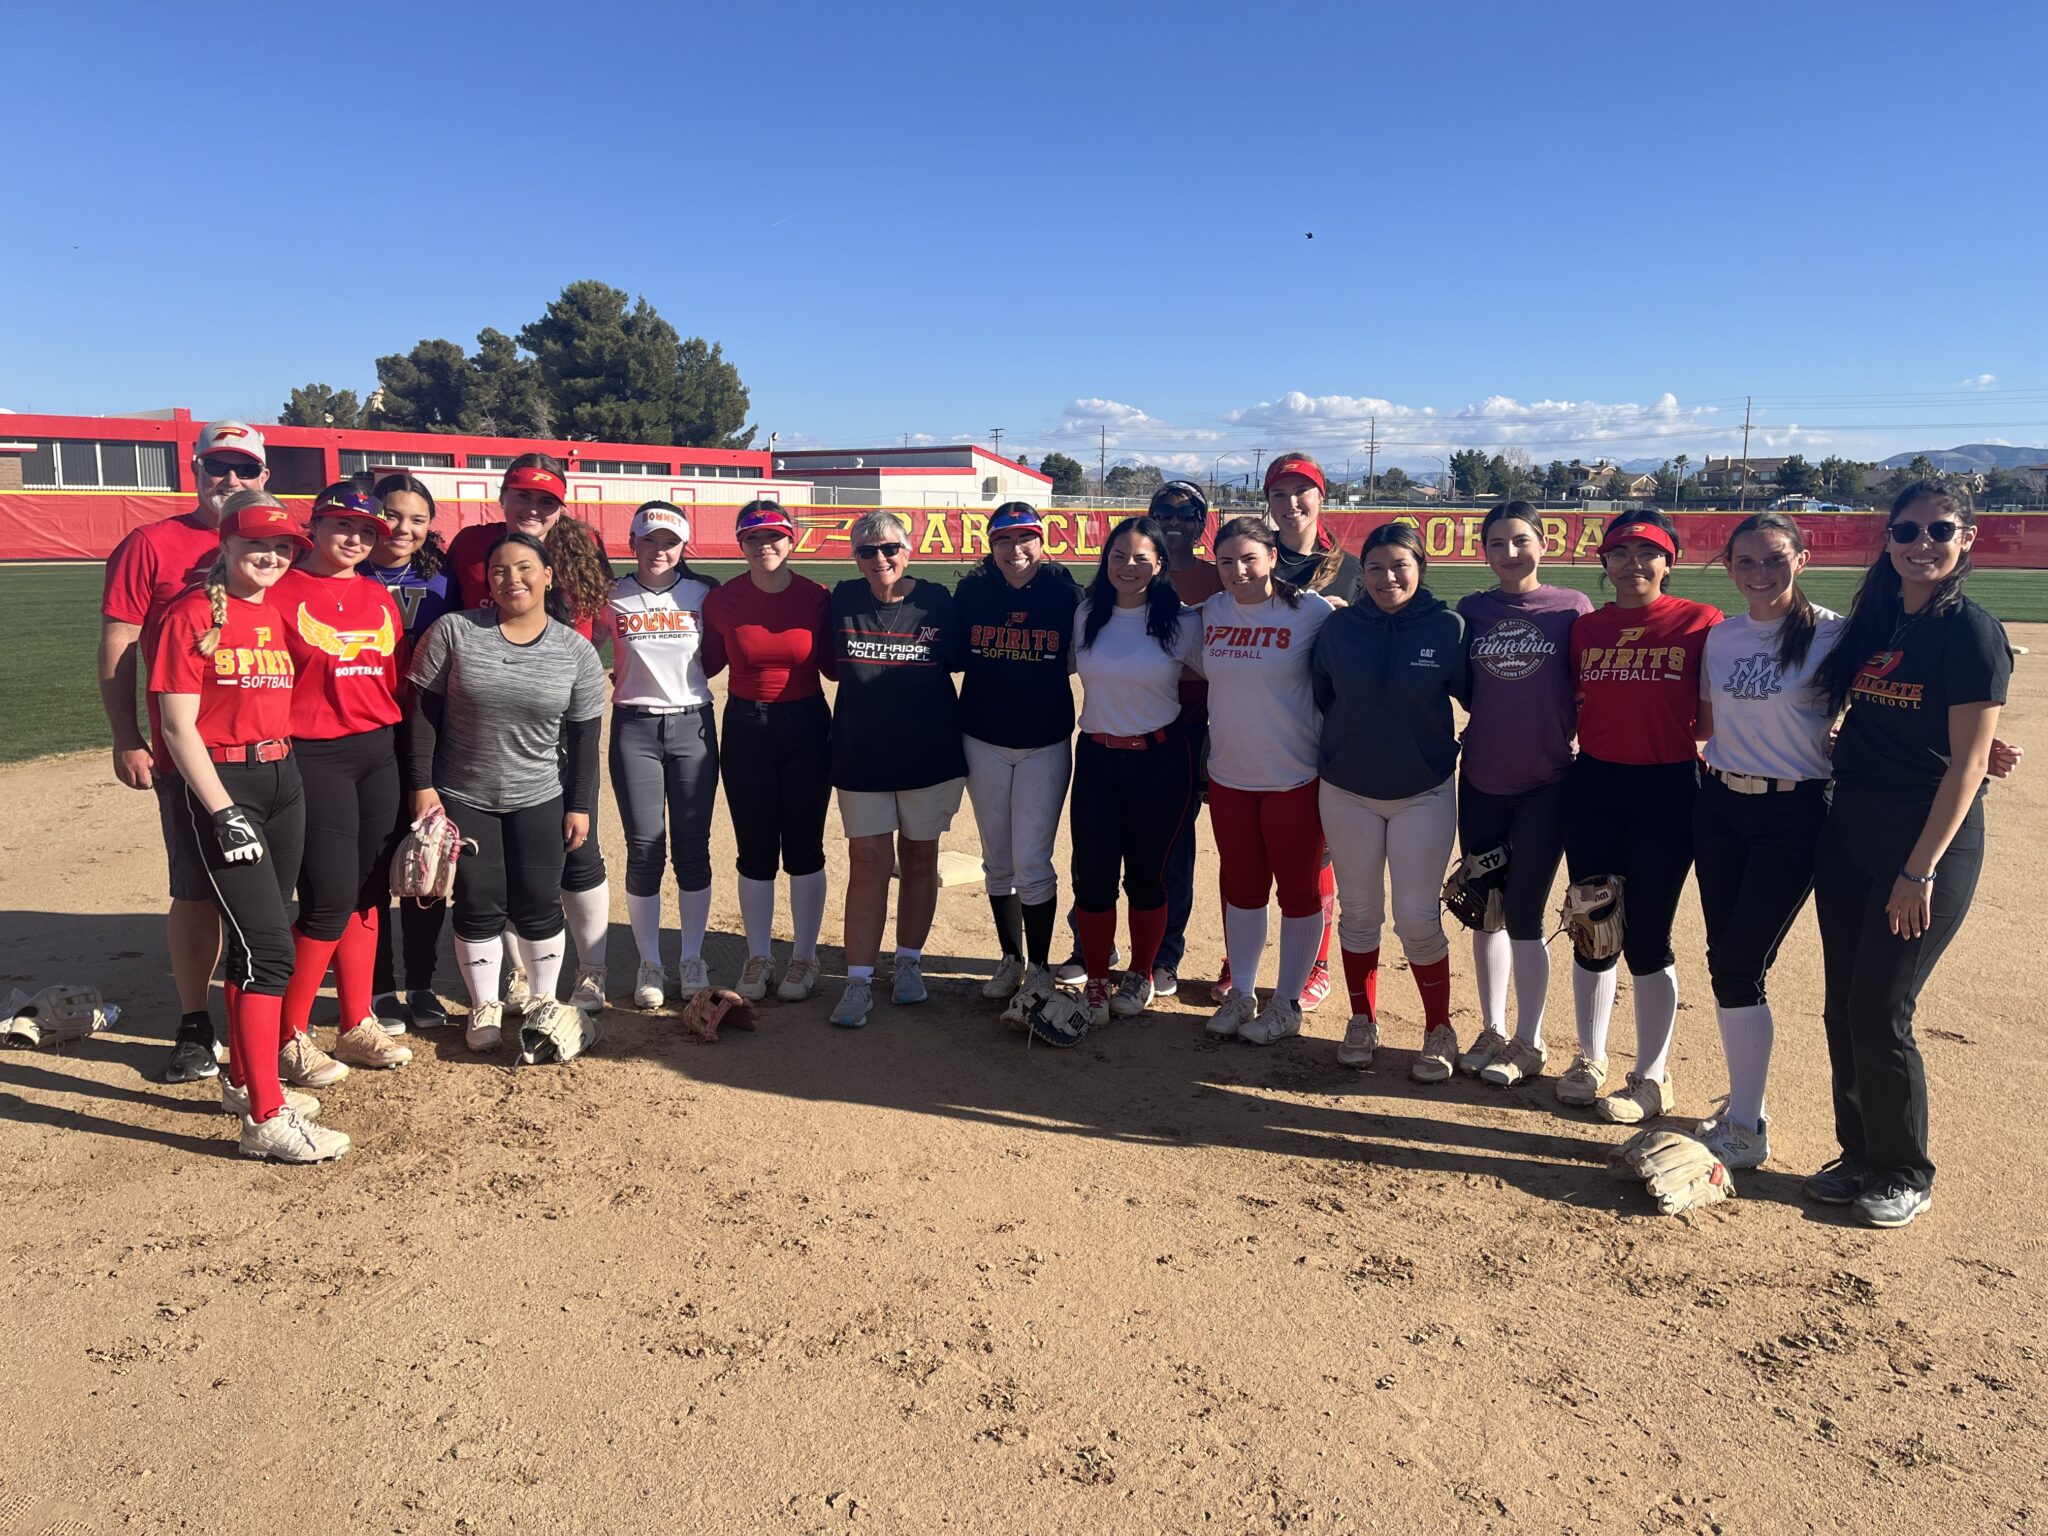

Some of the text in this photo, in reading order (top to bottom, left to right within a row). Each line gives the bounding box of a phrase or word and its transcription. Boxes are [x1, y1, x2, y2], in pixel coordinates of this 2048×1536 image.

[971, 625, 1060, 652] SPIRITS
[847, 640, 930, 654] NORTHRIDGE
[1208, 648, 1264, 660] SOFTBALL
[1420, 648, 1436, 658] CAT
[1470, 637, 1557, 660] California
[846, 649, 931, 662] VOLLEYBALL
[981, 647, 1042, 662] SOFTBALL
[1583, 669, 1661, 682] SOFTBALL
[1865, 695, 1921, 710] SCHOOL
